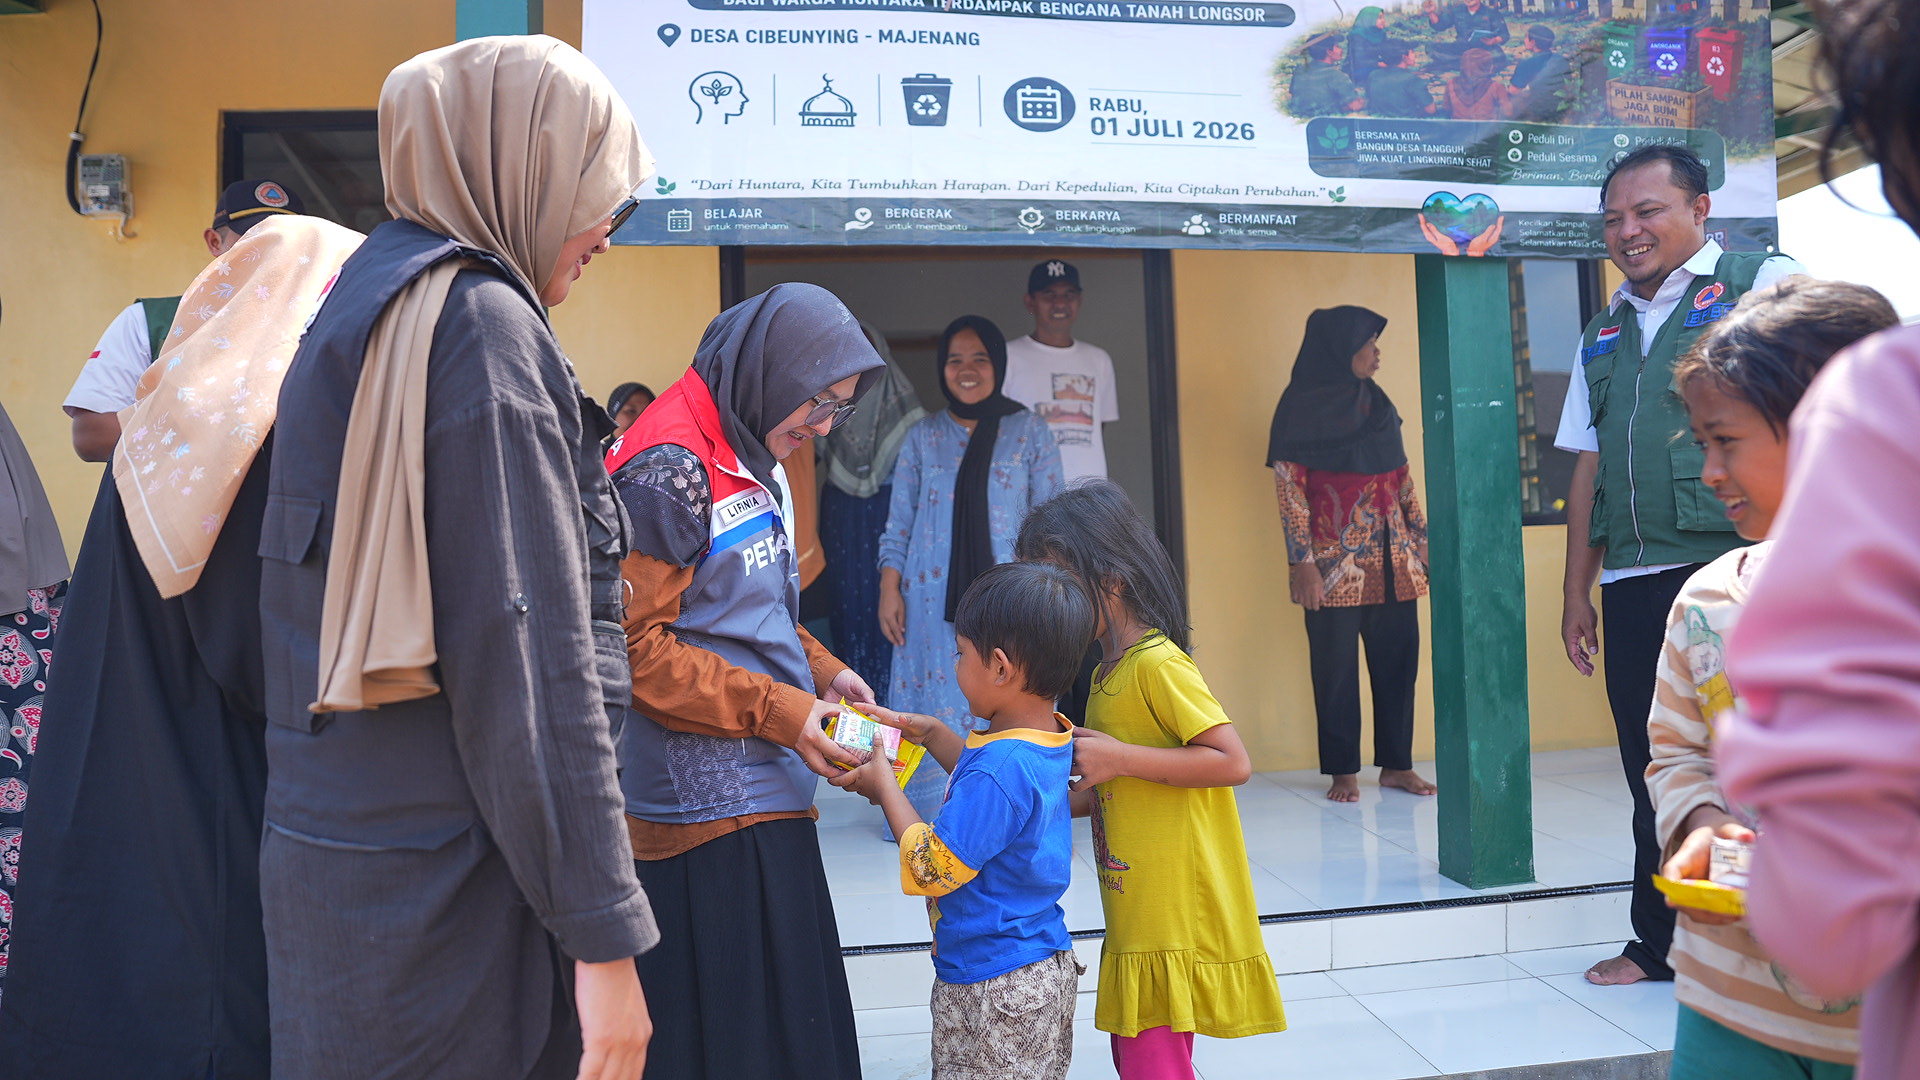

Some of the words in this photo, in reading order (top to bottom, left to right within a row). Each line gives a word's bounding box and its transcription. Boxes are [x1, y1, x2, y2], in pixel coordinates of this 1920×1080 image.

[1040, 2, 1121, 17] BENCANA
[1127, 5, 1183, 19] TANAH
[1189, 6, 1266, 22] LONGSOR
[690, 29, 739, 43] DESA
[746, 29, 859, 44] CIBEUNYING
[879, 30, 980, 46] MAJENANG
[1615, 89, 1643, 101] PILAH
[1646, 92, 1686, 107] SAMPAH
[1089, 97, 1148, 115] RABU,
[1624, 101, 1650, 113] JAGA
[1653, 104, 1678, 117] BUMI
[1625, 113, 1652, 125] JAGA
[1654, 116, 1676, 128] KITA
[1091, 116, 1118, 136] 01
[1127, 118, 1183, 138] JULI
[1192, 121, 1256, 141] 2026
[1355, 131, 1399, 140] BERSAMA
[1401, 132, 1421, 141] KITA
[1528, 133, 1556, 145] Peduli
[1558, 135, 1575, 145] Diri
[1356, 143, 1394, 151] BANGUN
[1396, 143, 1420, 152] DESA
[1423, 144, 1467, 155] TANGGUH,
[1357, 154, 1379, 163] JIWA
[1408, 155, 1465, 166] LINGKUNGAN
[1467, 158, 1492, 167] SEHAT
[1527, 151, 1556, 162] Peduli
[1558, 152, 1598, 163] Sesama
[1511, 168, 1564, 182] Beriman,
[738, 178, 805, 191] Huntara,
[811, 178, 843, 190] Kita
[849, 178, 937, 191] Tumbuhkan
[943, 179, 1011, 194] Harapan.
[1017, 180, 1051, 192] Dari
[1055, 181, 1138, 196] Kepedulian,
[1144, 183, 1173, 195] Kita
[1178, 183, 1240, 199] Ciptakan
[704, 208, 763, 219] BELAJAR
[885, 208, 954, 220] BERGERAK
[1055, 210, 1121, 222] BERKARYA
[1219, 212, 1298, 226] BERMANFAAT
[704, 222, 732, 231] untuk
[735, 222, 789, 231] memahami
[885, 222, 913, 231] untuk
[916, 222, 968, 232] membantu
[1055, 225, 1083, 233] untuk
[1085, 224, 1136, 235] lingkungan
[1518, 219, 1553, 228] Kecilkan
[1555, 219, 1590, 230] Sampah,
[1219, 227, 1245, 236] untuk
[1248, 228, 1278, 237] semua
[1519, 229, 1566, 238] Selamatkan
[1519, 239, 1568, 248] Selamatkan
[1569, 240, 1590, 249] Masa
[727, 496, 760, 518] LIFINIA
